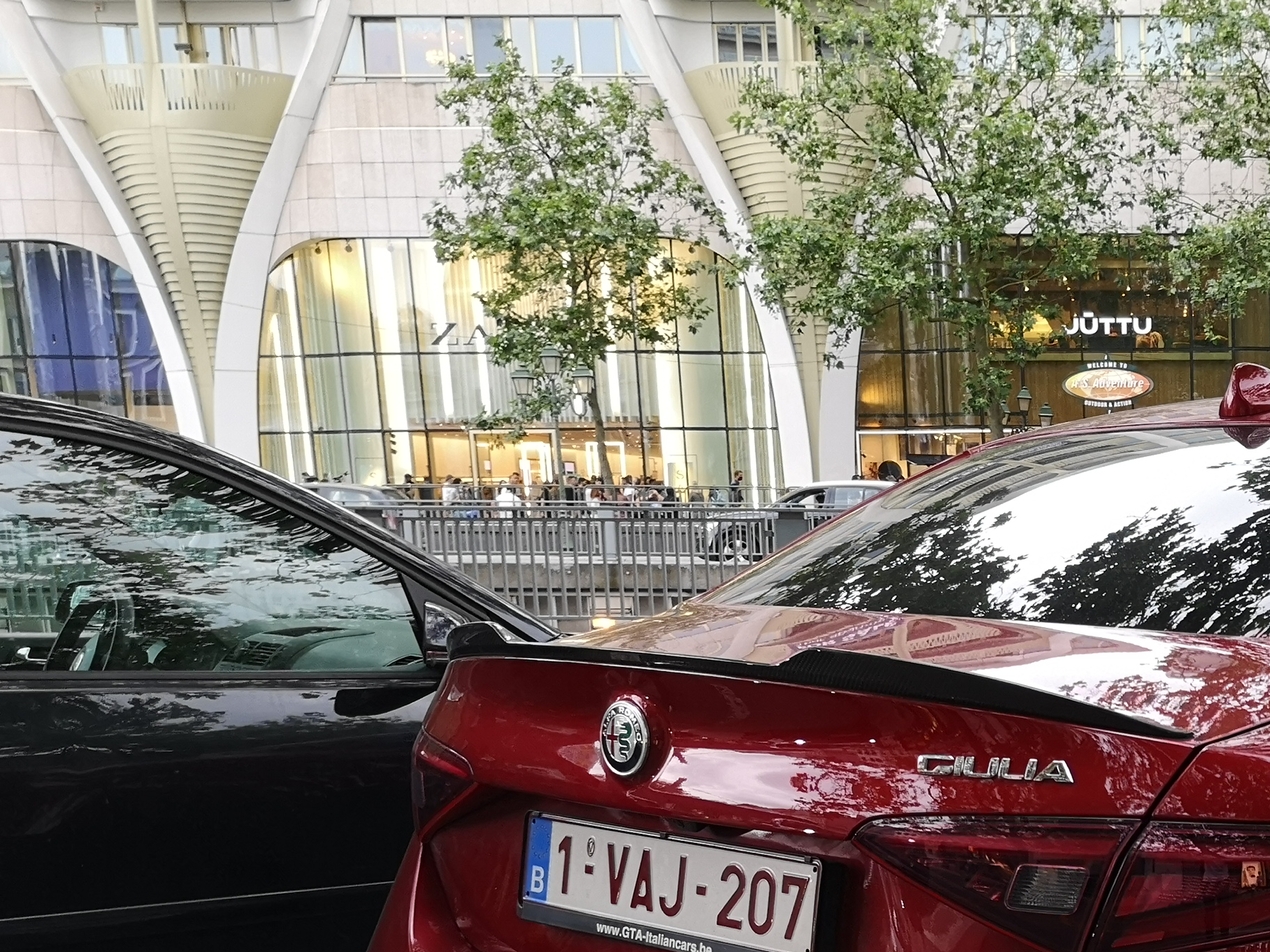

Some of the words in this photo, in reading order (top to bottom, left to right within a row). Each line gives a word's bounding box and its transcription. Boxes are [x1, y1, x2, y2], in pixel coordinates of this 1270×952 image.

[1093, 378, 1144, 389] Adventure
[1084, 400, 1108, 408] OUTDOOR
[1114, 400, 1132, 408] ACTION
[917, 754, 1074, 783] GIULIA
[530, 865, 545, 893] B
[558, 835, 811, 940] 1-VAJ-207
